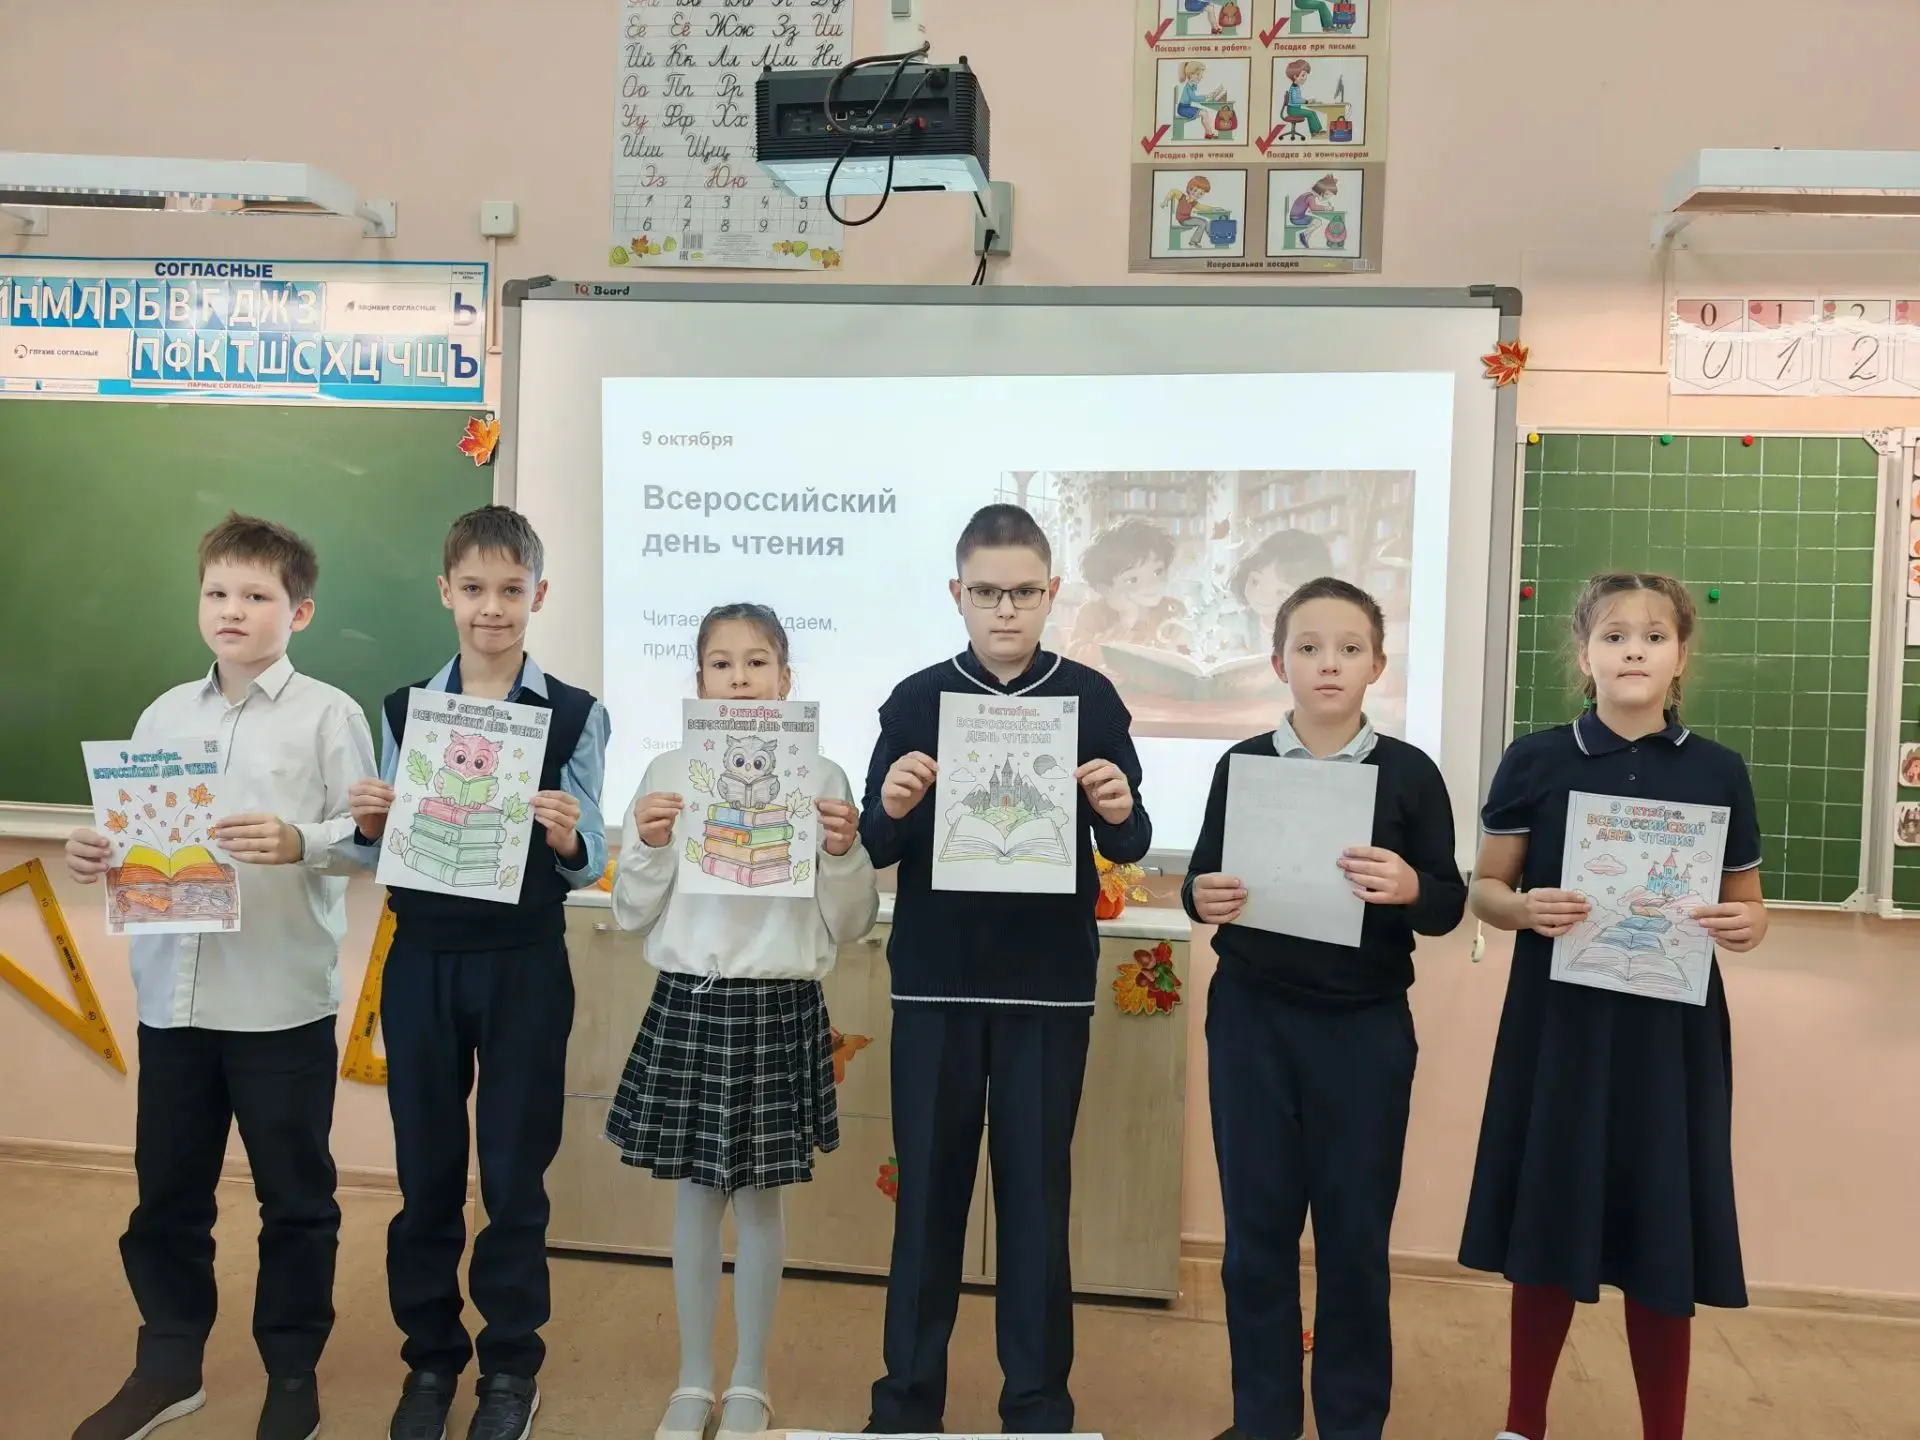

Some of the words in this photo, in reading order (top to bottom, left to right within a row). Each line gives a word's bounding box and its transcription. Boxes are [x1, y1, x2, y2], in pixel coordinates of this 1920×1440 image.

[1155, 45, 1185, 53] Посадка
[1274, 43, 1307, 51] Посадка
[1154, 152, 1186, 160] Посадка
[1267, 151, 1300, 159] Посадка
[155, 262, 273, 278] СОГЛАСНЫЕ
[593, 285, 630, 296] Board
[1701, 303, 1717, 326] 0
[1775, 303, 1783, 324] 1
[1777, 337, 1801, 380] 1
[1849, 335, 1879, 380] 2
[642, 431, 652, 446] 9
[657, 431, 733, 449] октября
[643, 485, 897, 517] Всероссийский
[642, 533, 720, 557] день
[732, 535, 844, 556] чтения
[643, 611, 701, 626] Читае
[447, 699, 456, 711] 9
[978, 703, 986, 714] 9
[719, 705, 728, 717] 9
[730, 706, 782, 721] октября.
[484, 721, 508, 733] ДЕНЬ
[966, 731, 999, 743] ДЕНЬ
[1610, 801, 1621, 814] 9
[1596, 828, 1635, 842] ДЕНЬ
[1639, 832, 1696, 847] ЧТЕНИЯ
